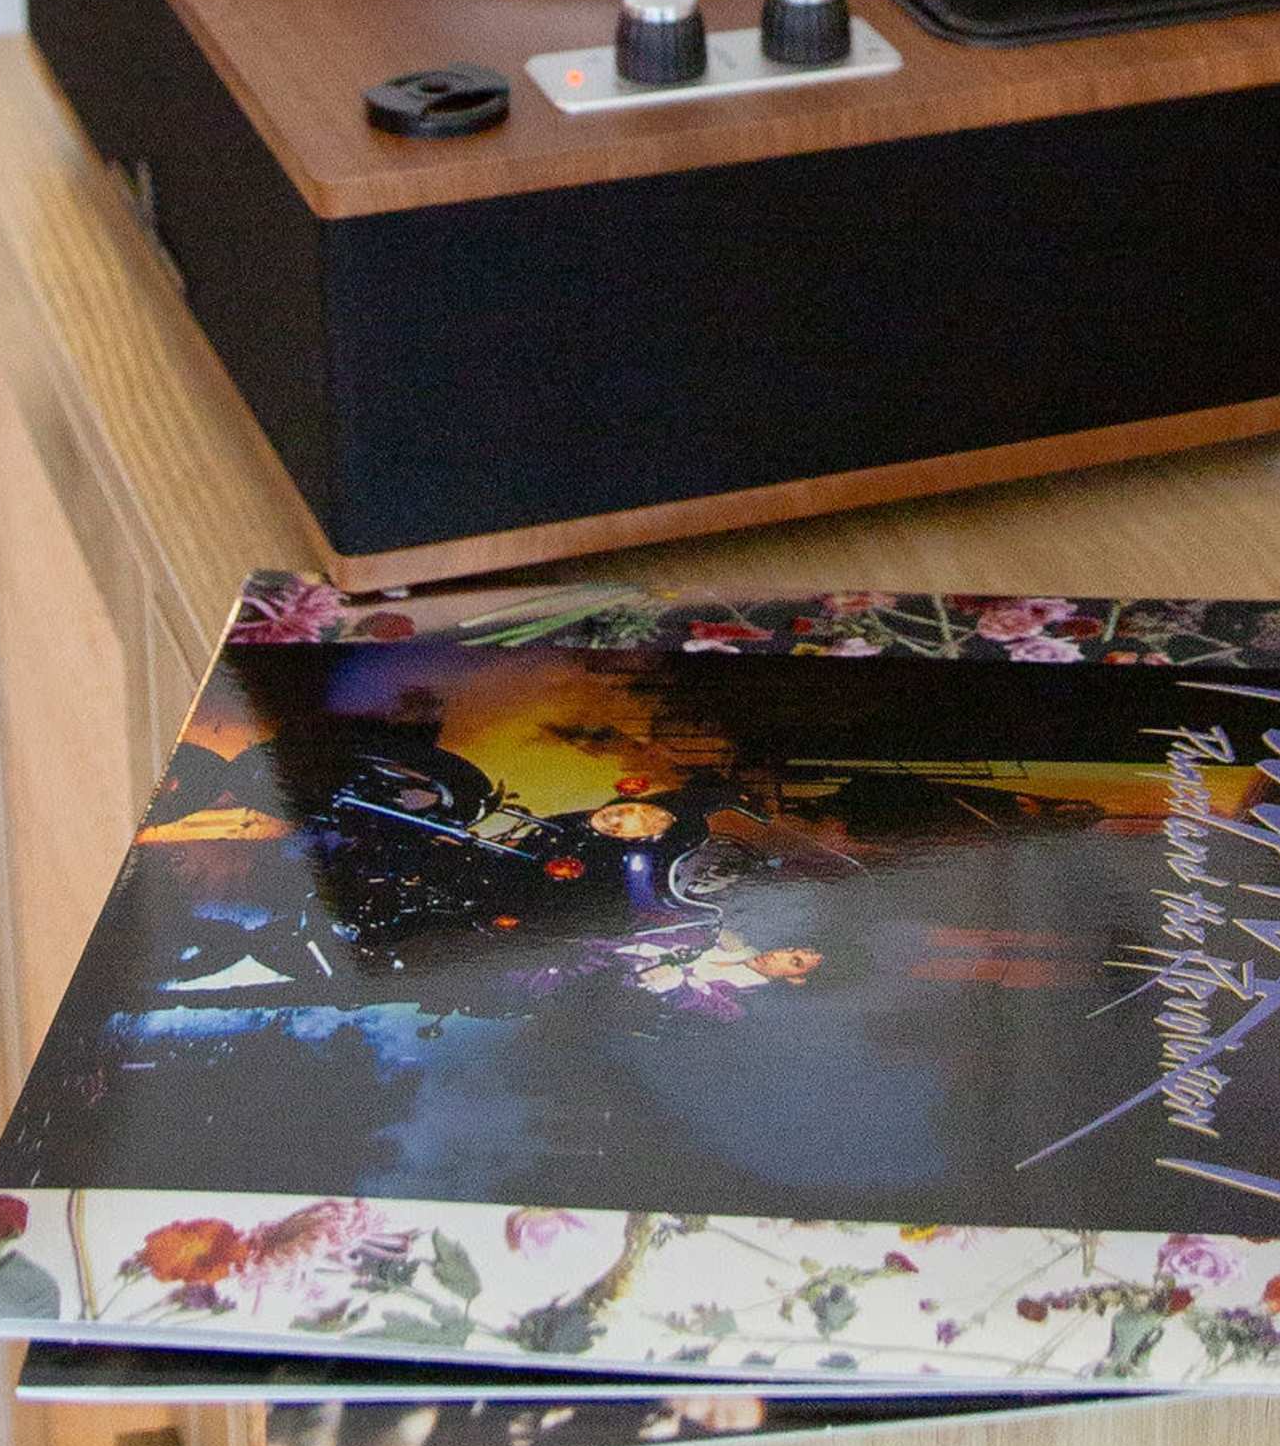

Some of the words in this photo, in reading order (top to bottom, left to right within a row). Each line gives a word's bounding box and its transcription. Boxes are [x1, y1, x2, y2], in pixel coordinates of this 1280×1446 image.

[1132, 726, 1235, 817] Prince
[1163, 817, 1228, 887] and
[1150, 891, 1226, 943] the
[1086, 944, 1254, 1138] Revolution
